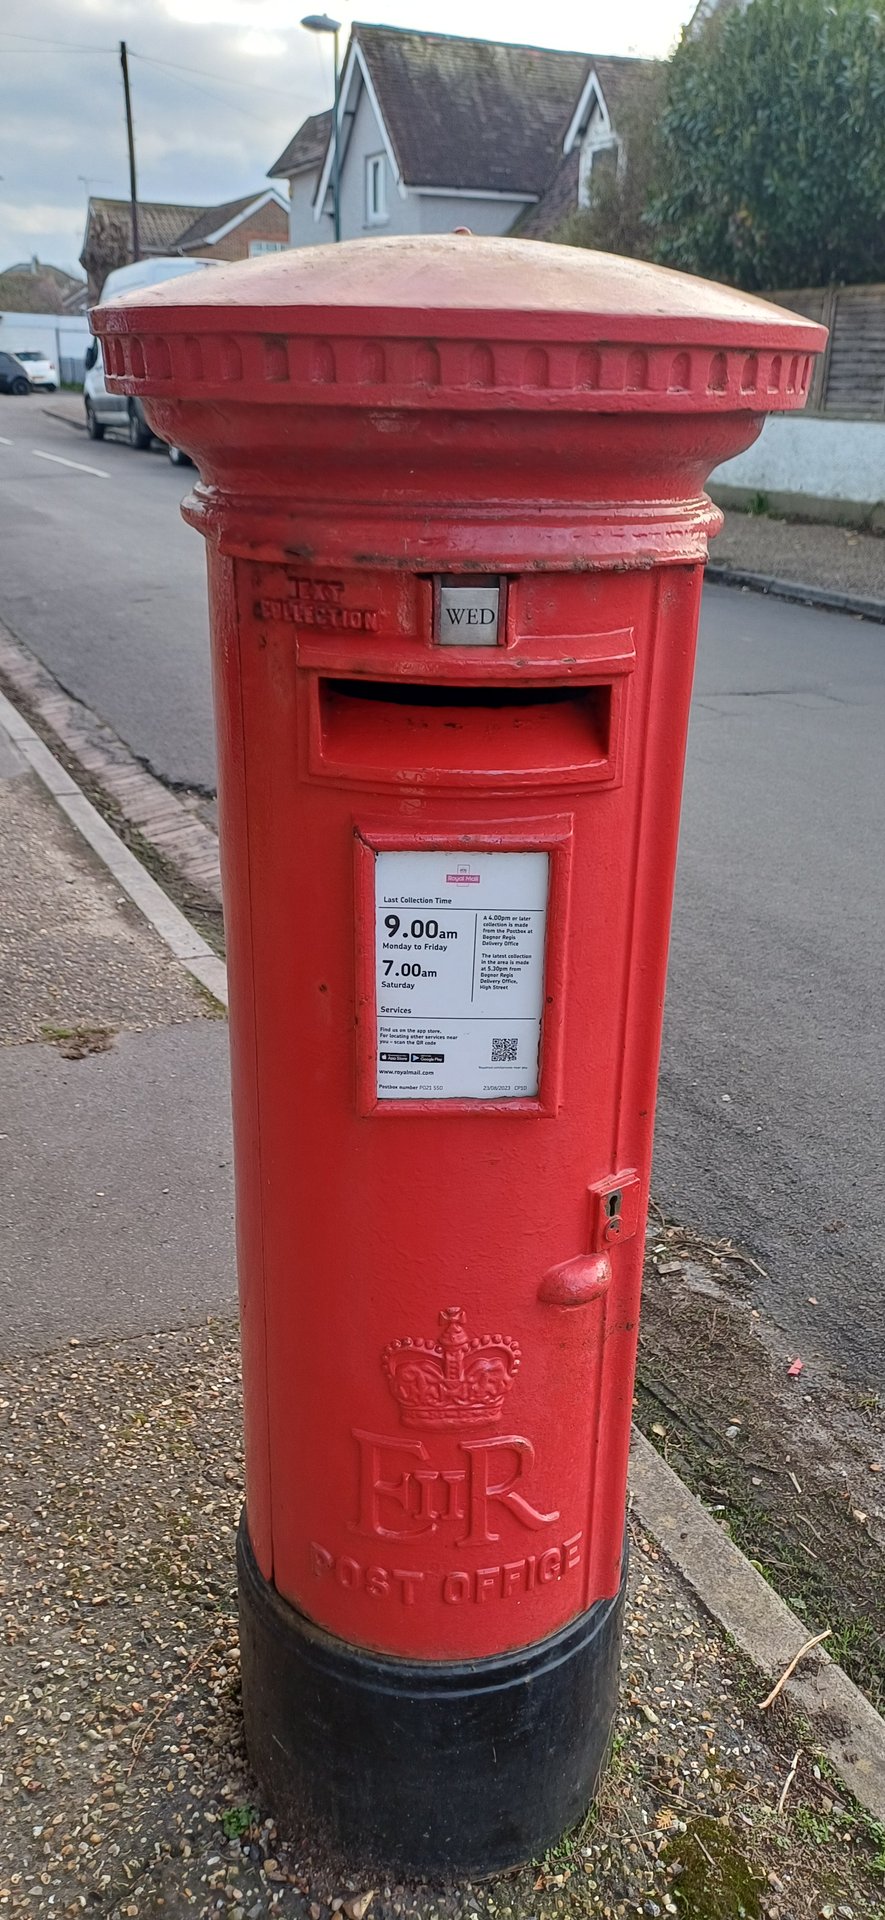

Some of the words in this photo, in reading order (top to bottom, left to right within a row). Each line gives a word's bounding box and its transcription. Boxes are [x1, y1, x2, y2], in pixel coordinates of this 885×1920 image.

[446, 608, 495, 625] WED
[384, 914, 458, 939] 9.00am
[382, 943, 412, 951] Monday
[424, 944, 448, 952] Friday
[382, 960, 437, 977] 7.00am
[381, 981, 415, 989] Saturday
[310, 1542, 424, 1605] POST
[443, 1530, 582, 1604] OFFICE
